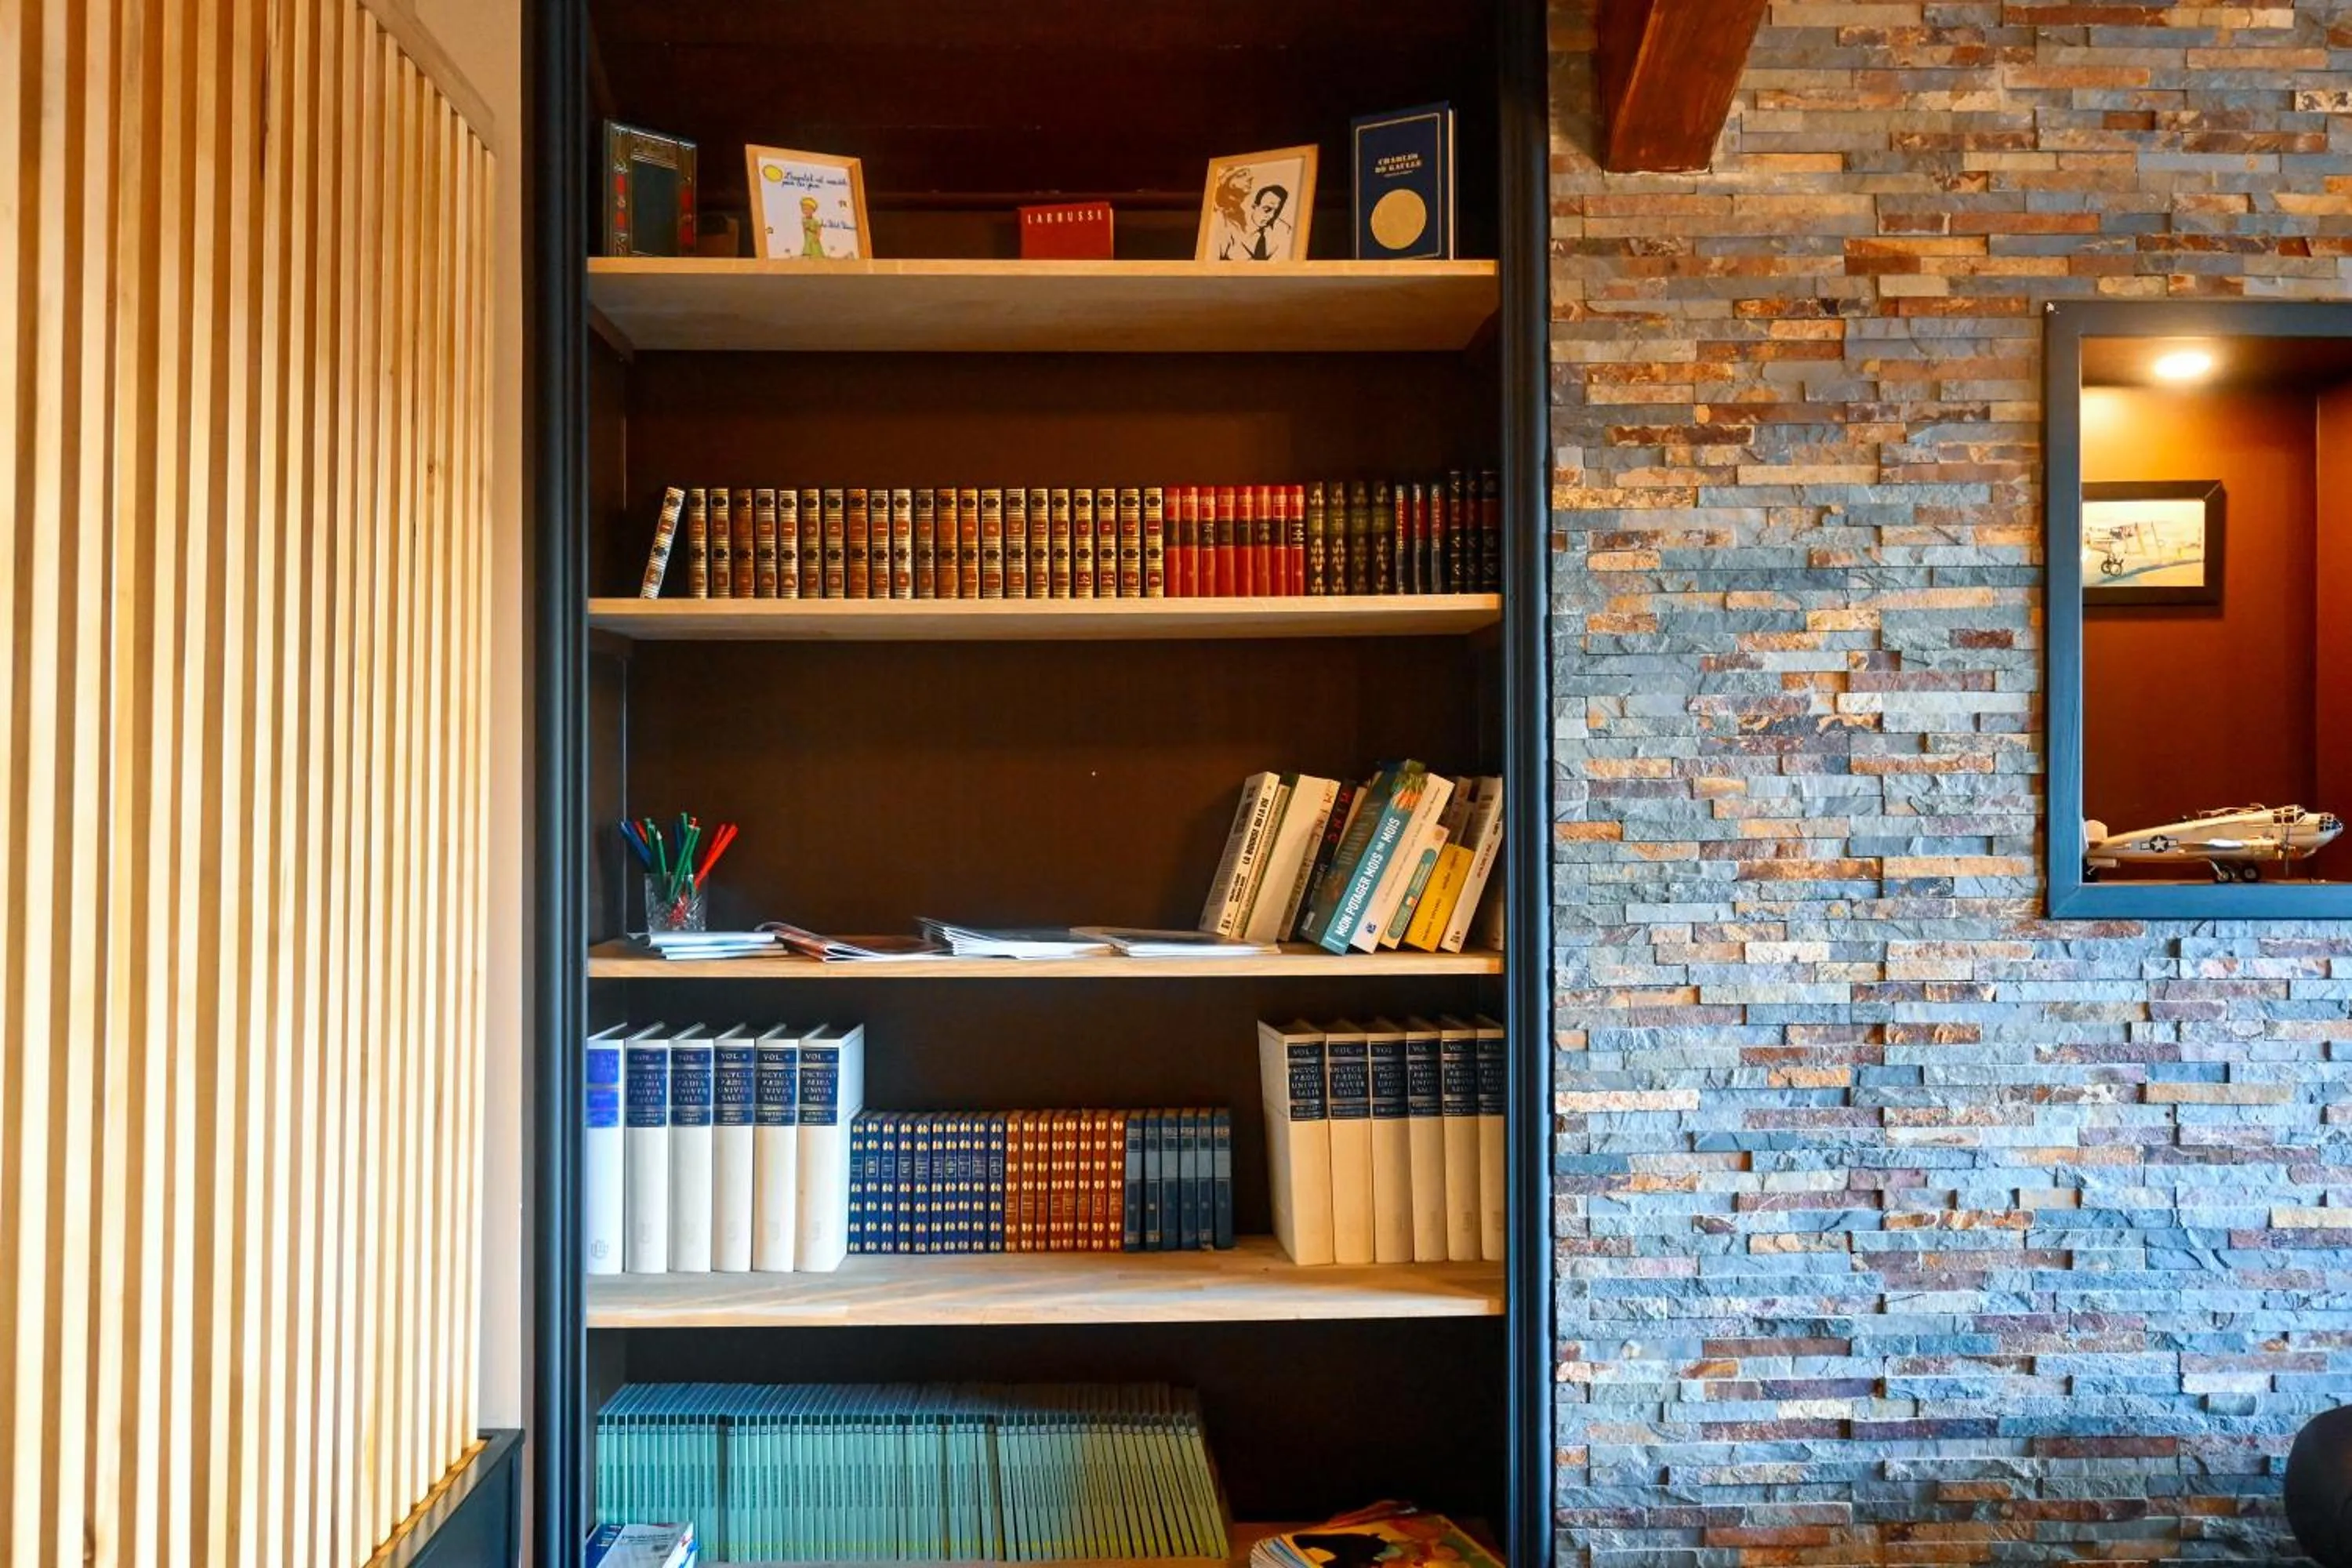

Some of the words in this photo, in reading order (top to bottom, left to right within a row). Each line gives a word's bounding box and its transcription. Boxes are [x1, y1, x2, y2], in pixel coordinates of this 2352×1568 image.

[1027, 209, 1102, 225] LAROUSSE
[1334, 914, 1352, 937] MON
[1345, 877, 1372, 916] POTAGER
[1363, 852, 1384, 879] MOIS
[1381, 816, 1400, 843] MOIS
